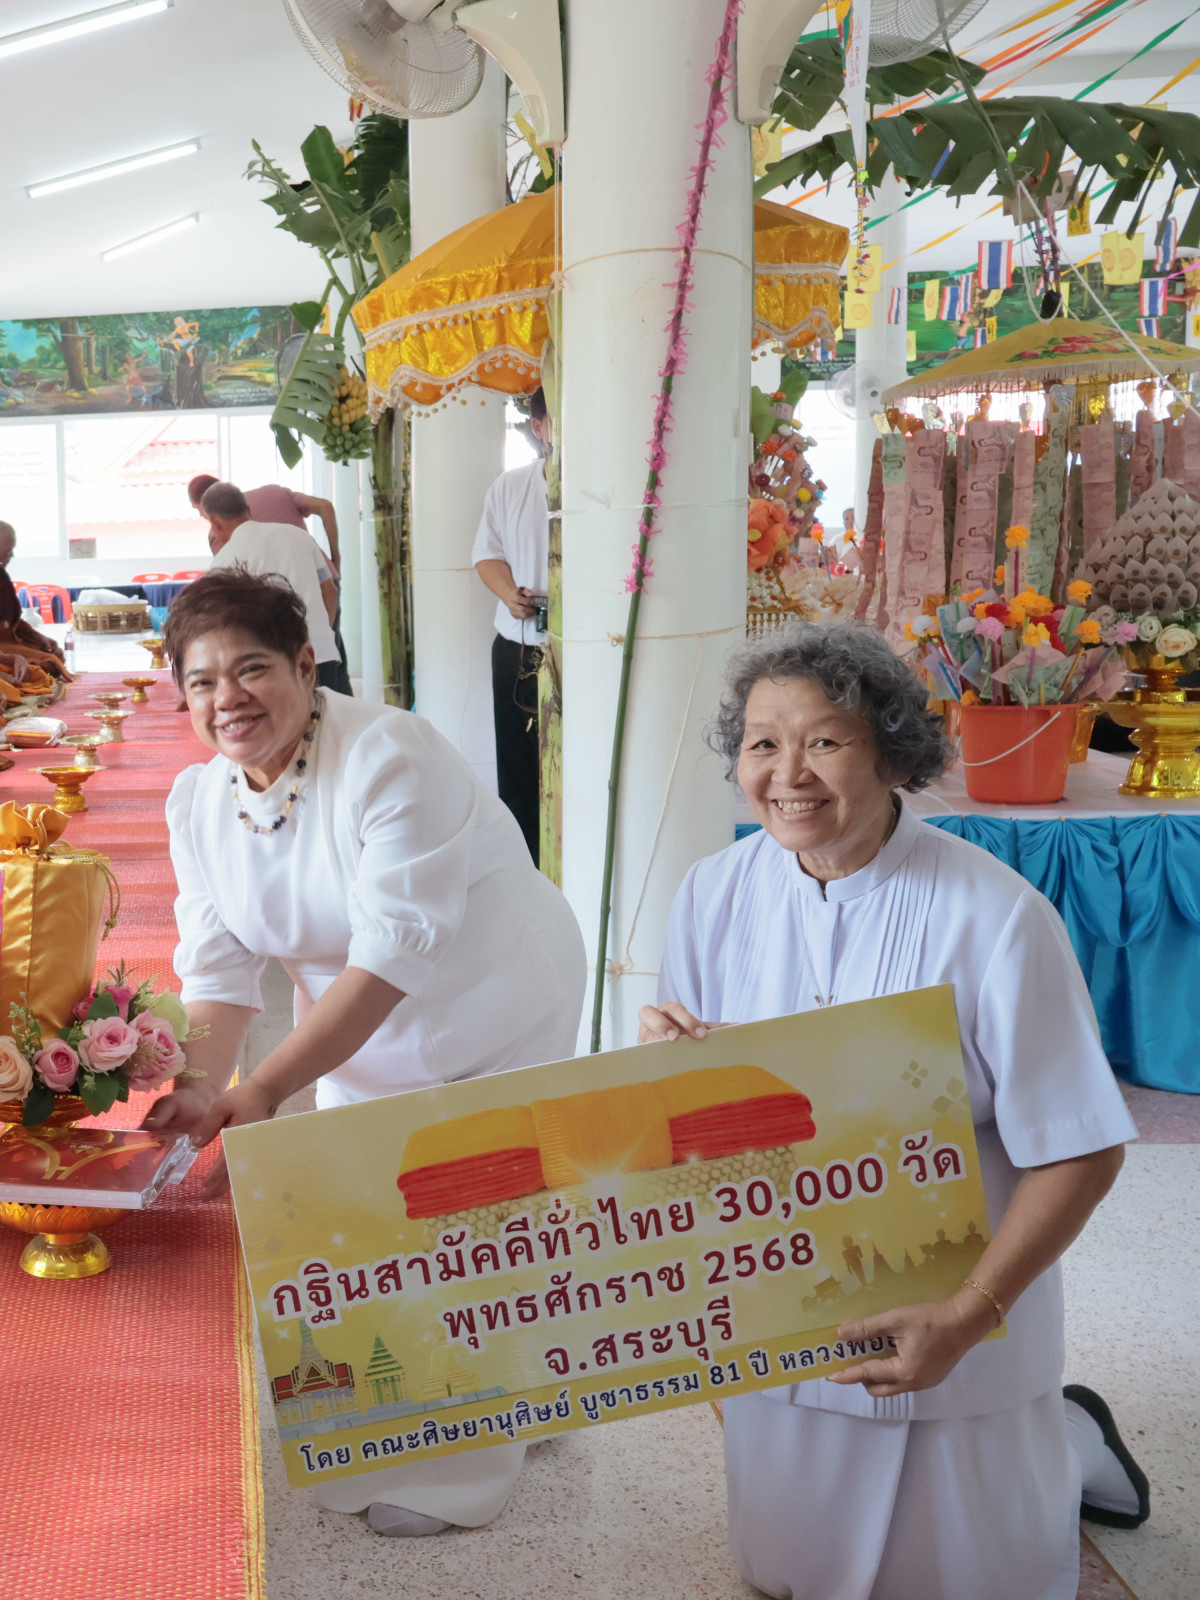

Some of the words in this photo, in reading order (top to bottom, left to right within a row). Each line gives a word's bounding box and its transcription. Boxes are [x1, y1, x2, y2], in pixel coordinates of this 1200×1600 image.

[273, 1197, 696, 1324] กฐินสามัคคีทั่วไทย
[715, 1157, 884, 1223] 30,000
[903, 1134, 961, 1184] วัด
[442, 1261, 686, 1349] พุทธศักราช
[704, 1232, 815, 1285] 2568
[544, 1295, 734, 1376] จ.สระบุรี
[300, 1443, 352, 1472] โดย
[361, 1389, 571, 1458] คณะศิษยานุศิษย์
[579, 1373, 700, 1421] บูชาธรรม
[709, 1361, 742, 1387] 81
[748, 1349, 770, 1377] ปี
